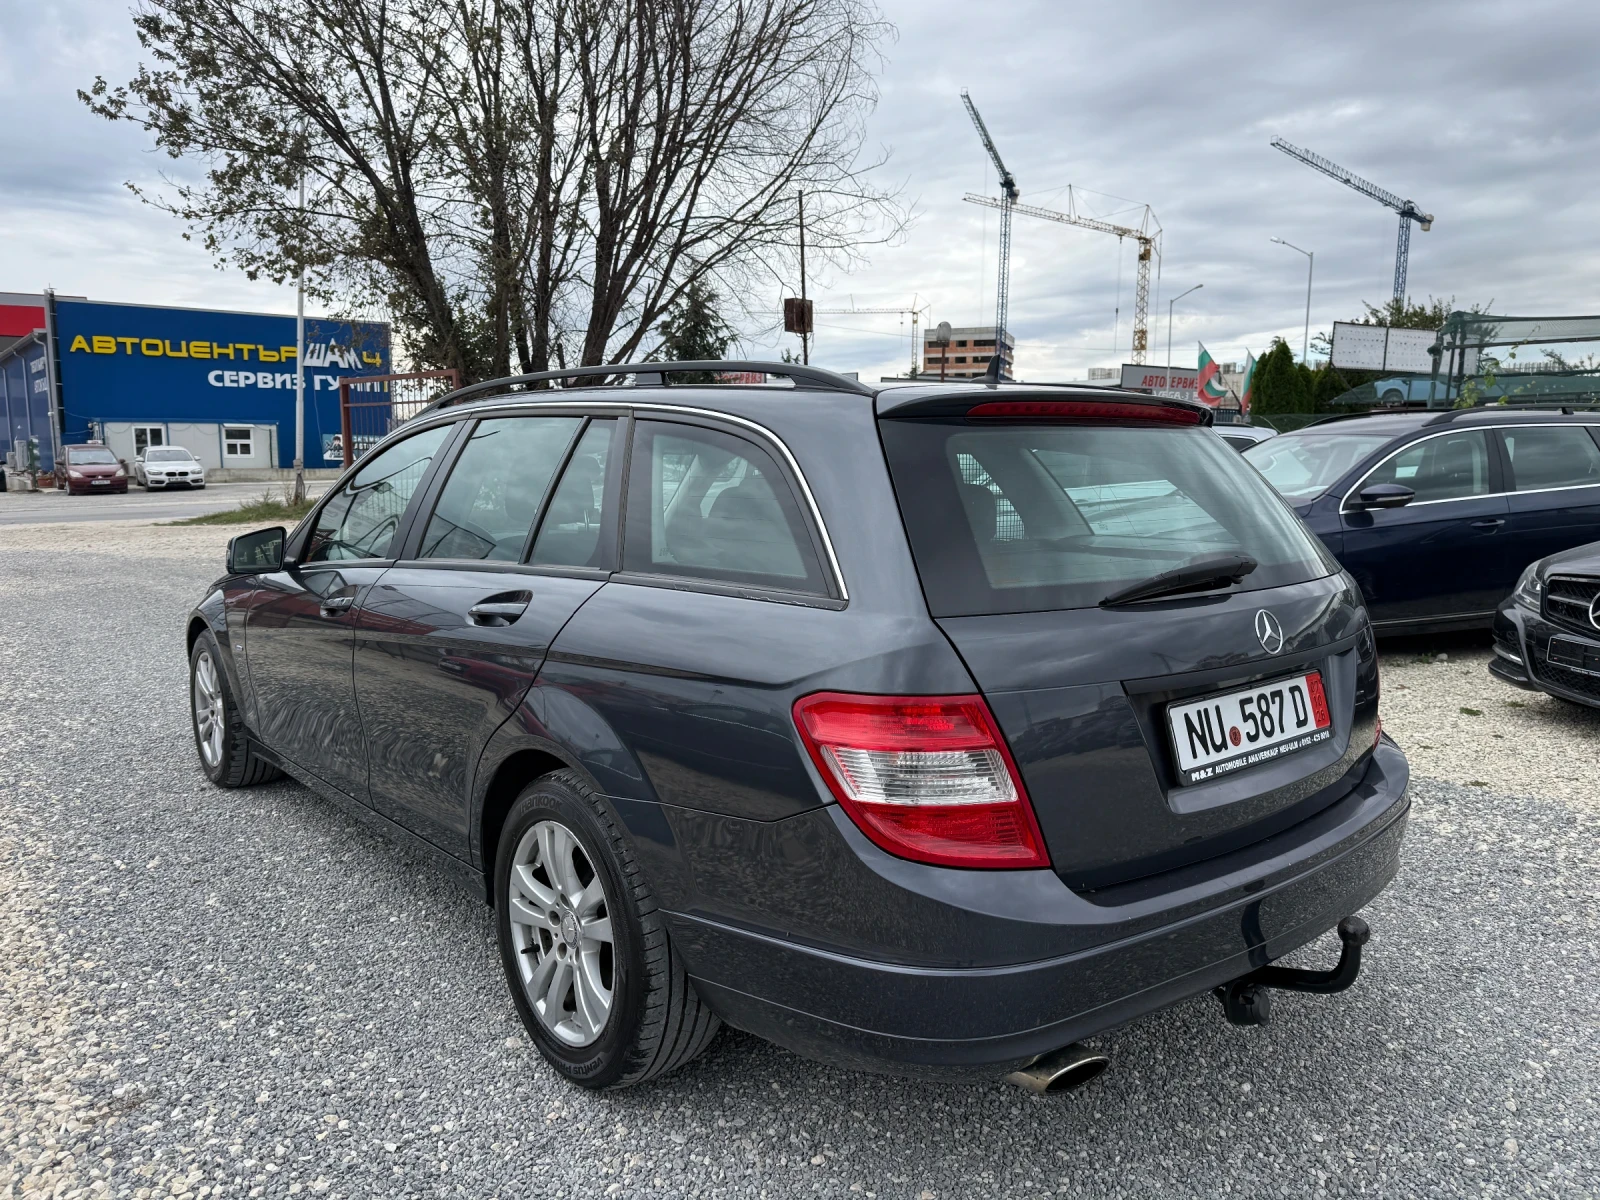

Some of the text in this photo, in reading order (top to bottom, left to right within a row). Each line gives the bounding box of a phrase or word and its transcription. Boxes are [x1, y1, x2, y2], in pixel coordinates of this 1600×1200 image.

[69, 334, 298, 364] АВТОЦЕНТЪР
[303, 337, 363, 370] ШАМ
[207, 369, 306, 390] СЕРВИЗ
[1183, 684, 1309, 760] NU 587 D
[1215, 757, 1248, 774] AUTOMOBILE
